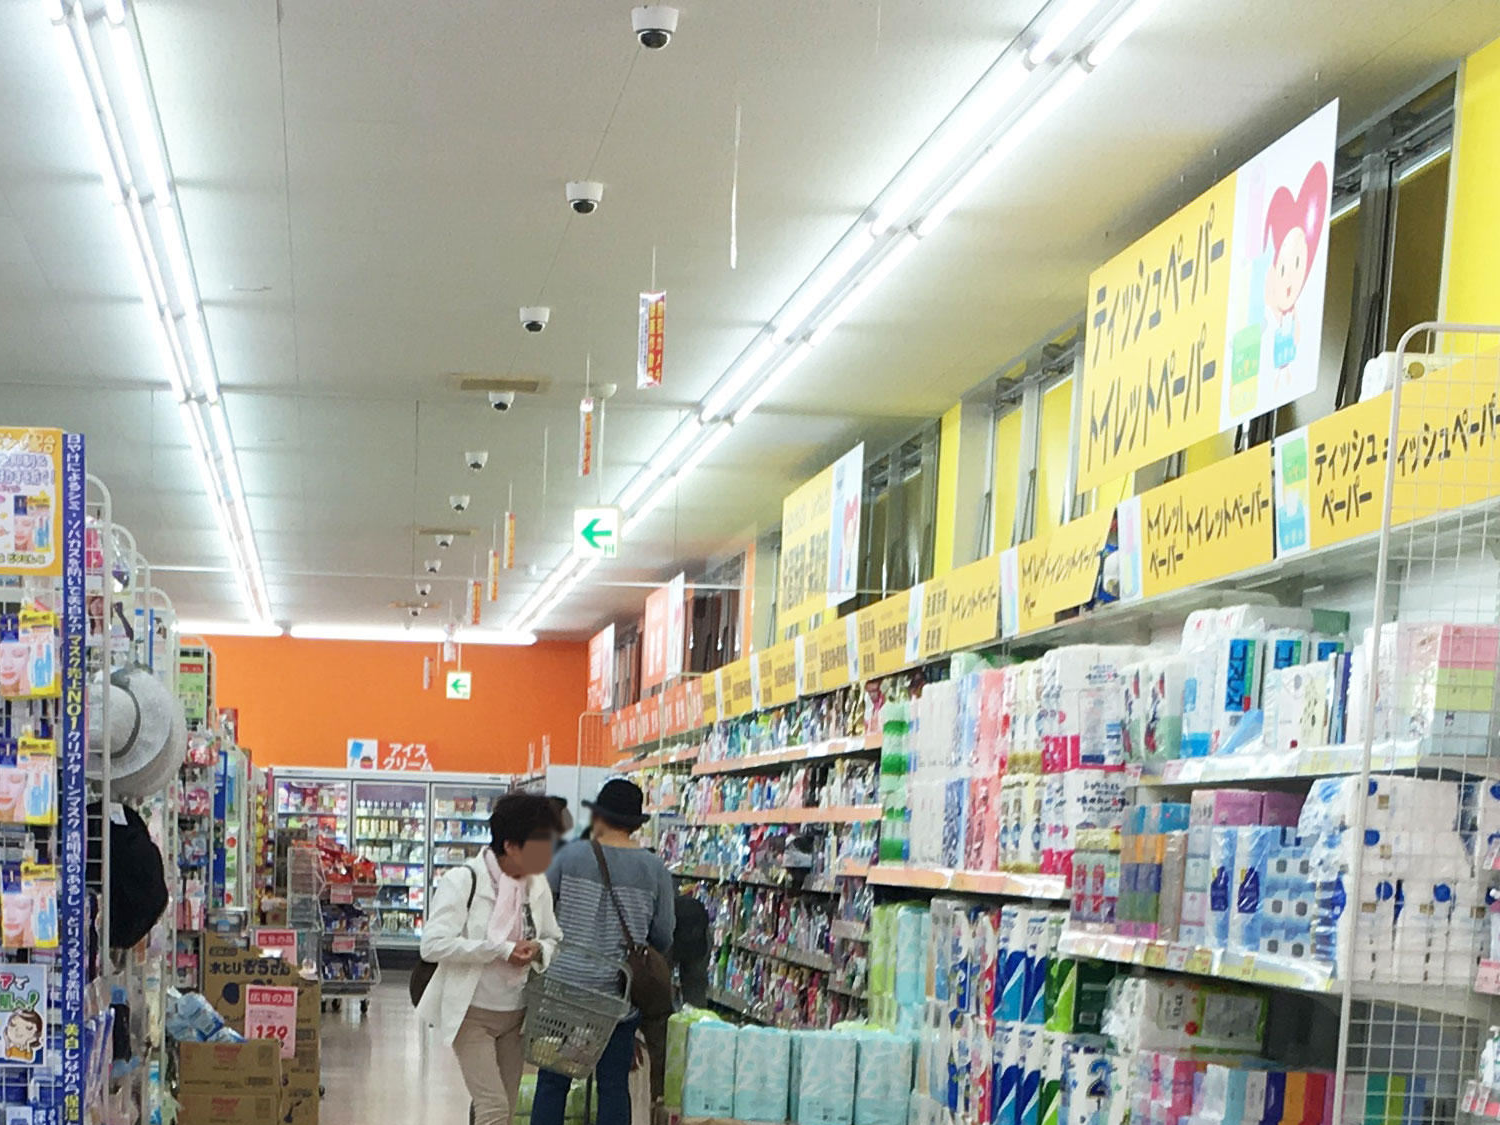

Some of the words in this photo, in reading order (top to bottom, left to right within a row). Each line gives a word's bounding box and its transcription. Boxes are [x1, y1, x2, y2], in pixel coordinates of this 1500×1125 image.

[1092, 202, 1225, 367] ティッシュペーパー
[1087, 322, 1217, 472] トイレットペーパー
[1315, 430, 1377, 485] ティッシュ
[1322, 475, 1372, 526] ペーパー
[1187, 482, 1269, 550] トイレットペーパー
[1150, 540, 1184, 579] ペーパー
[382, 757, 434, 772] クリーム
[388, 743, 427, 759] アイス
[258, 933, 294, 944] 広告の品
[208, 959, 290, 976] 水とりぞうさん
[250, 992, 294, 1004] 広告の品
[256, 1024, 288, 1040] 129
